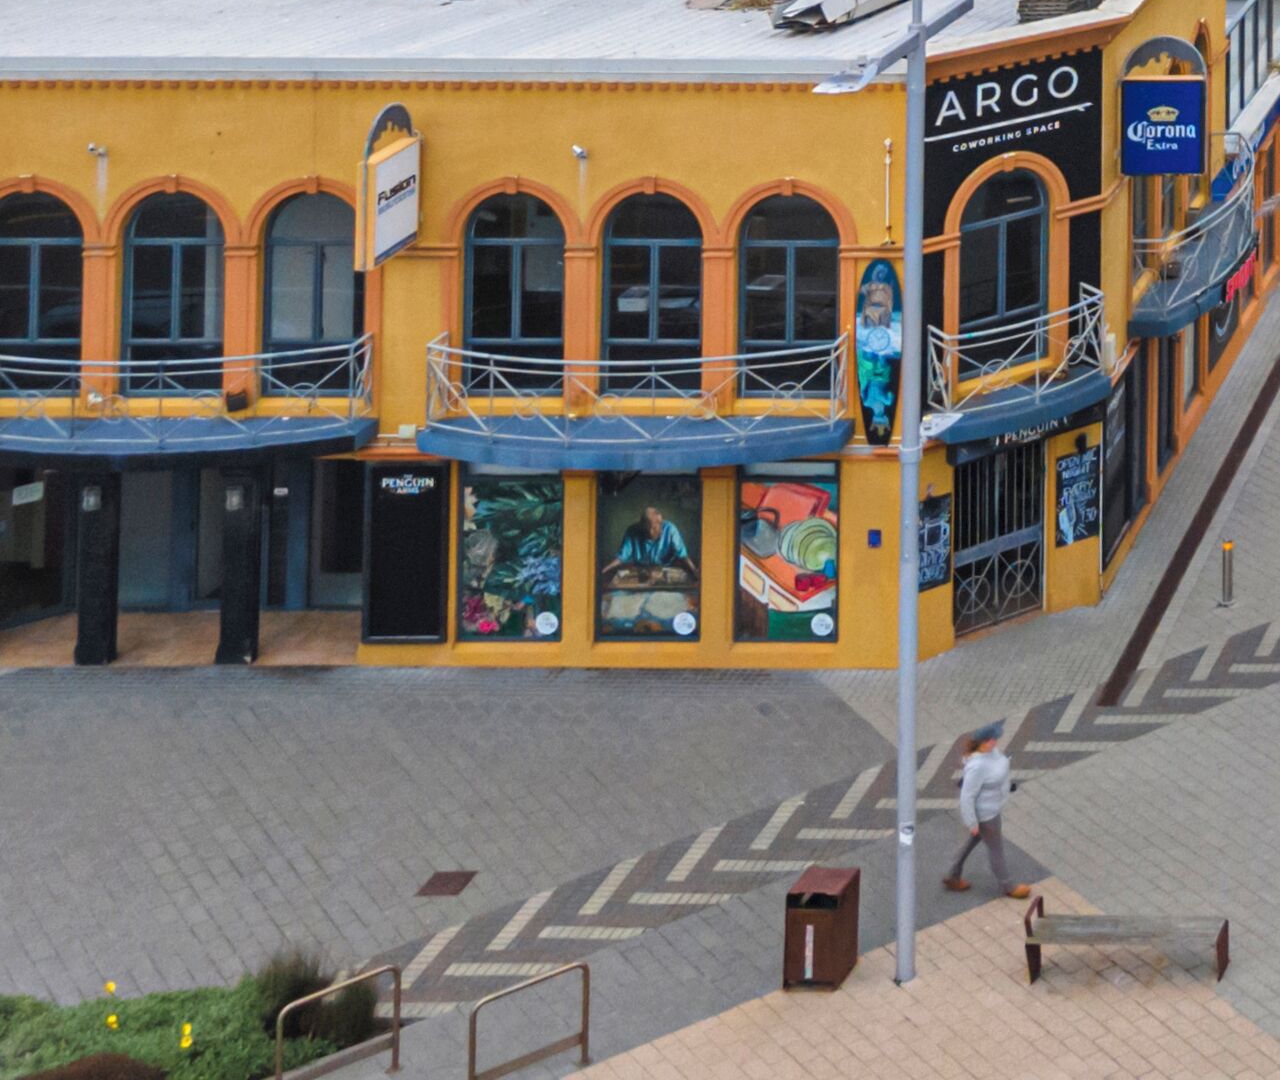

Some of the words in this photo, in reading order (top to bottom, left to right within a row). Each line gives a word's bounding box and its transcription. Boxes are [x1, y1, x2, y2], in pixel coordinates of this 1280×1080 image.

[934, 65, 1079, 127] ARGO
[952, 129, 1022, 152] COWORKING
[1025, 120, 1061, 136] SPACE
[1127, 121, 1197, 144] Corona
[1147, 139, 1179, 151] Extra
[381, 477, 435, 488] PENGUIN
